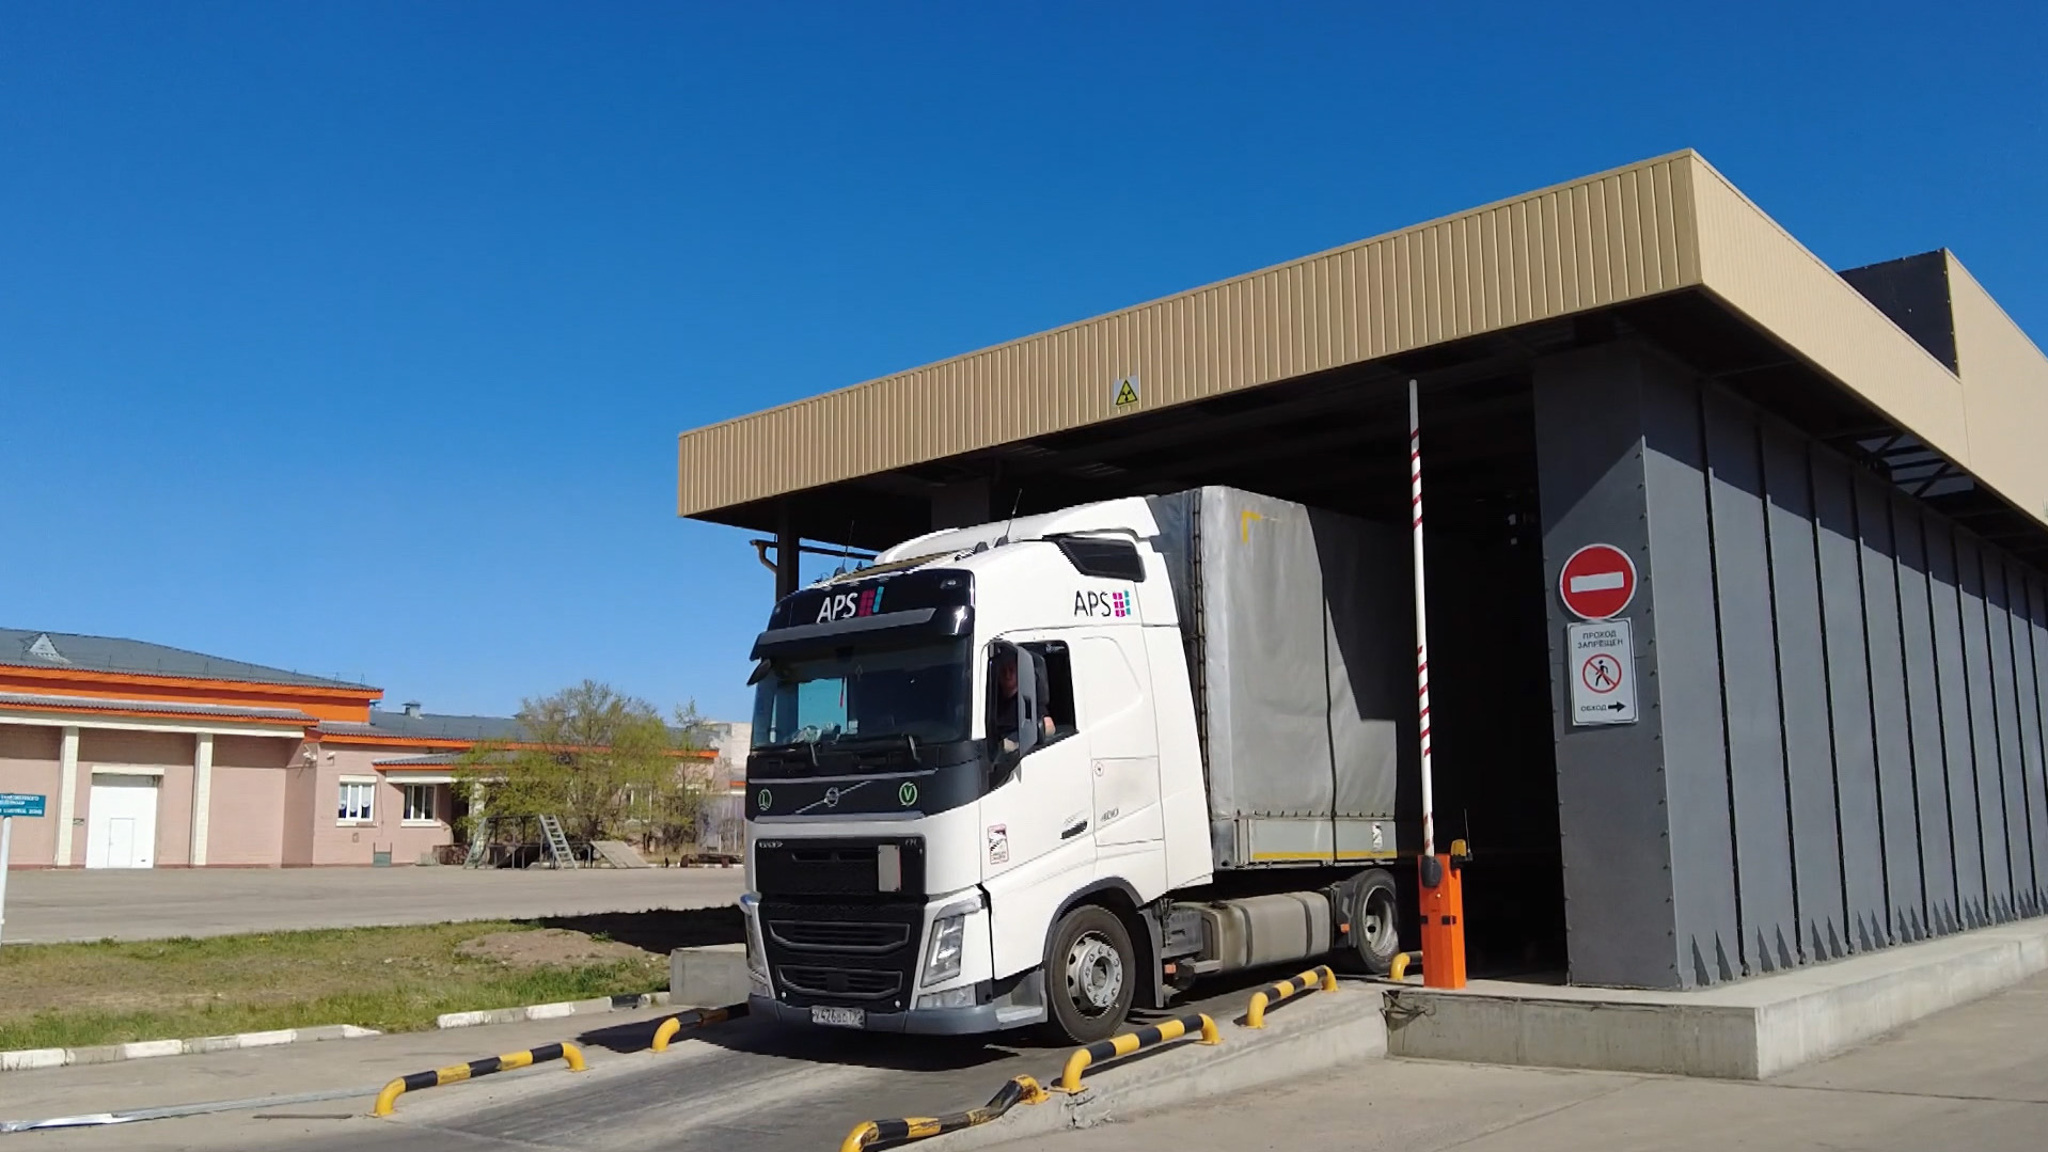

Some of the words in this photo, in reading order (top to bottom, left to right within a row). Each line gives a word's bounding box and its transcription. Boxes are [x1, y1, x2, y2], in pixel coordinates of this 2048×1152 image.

[816, 592, 858, 624] APS
[1074, 590, 1111, 617] APS
[1582, 630, 1617, 640] ПРОХОД
[1578, 638, 1623, 649] ЗАПРЕЩЕН
[1581, 703, 1607, 712] ОБХОД
